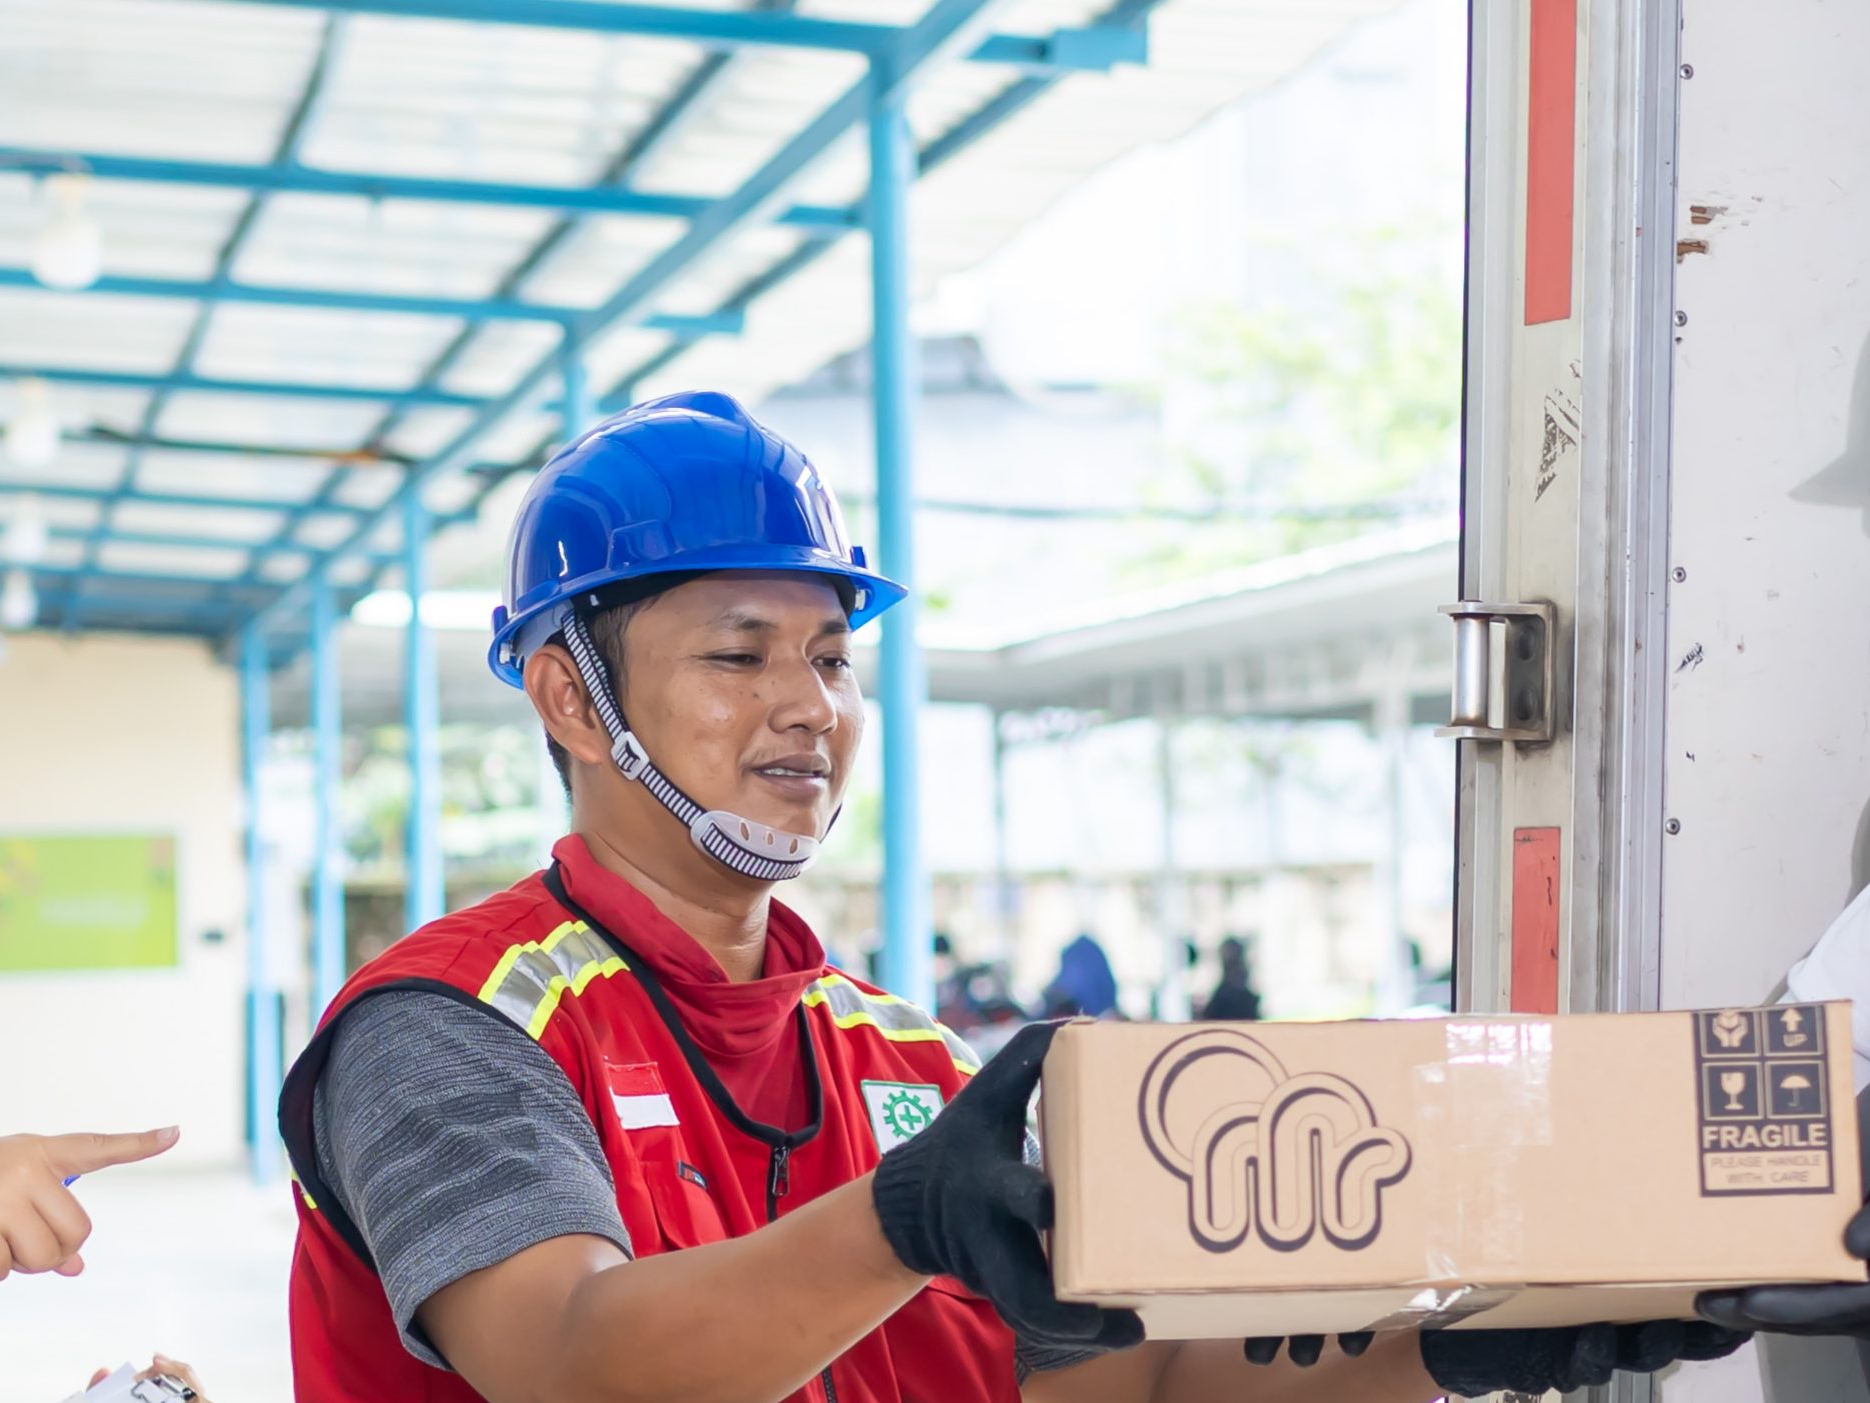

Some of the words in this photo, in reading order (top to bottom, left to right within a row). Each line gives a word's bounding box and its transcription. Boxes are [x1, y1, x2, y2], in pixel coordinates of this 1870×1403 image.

[1702, 1123, 1828, 1149] FRAGILE
[1711, 1155, 1762, 1168] PLEASE
[1767, 1154, 1822, 1167] HANDLE
[1725, 1172, 1764, 1184] WITH
[1770, 1171, 1810, 1183] CARE
